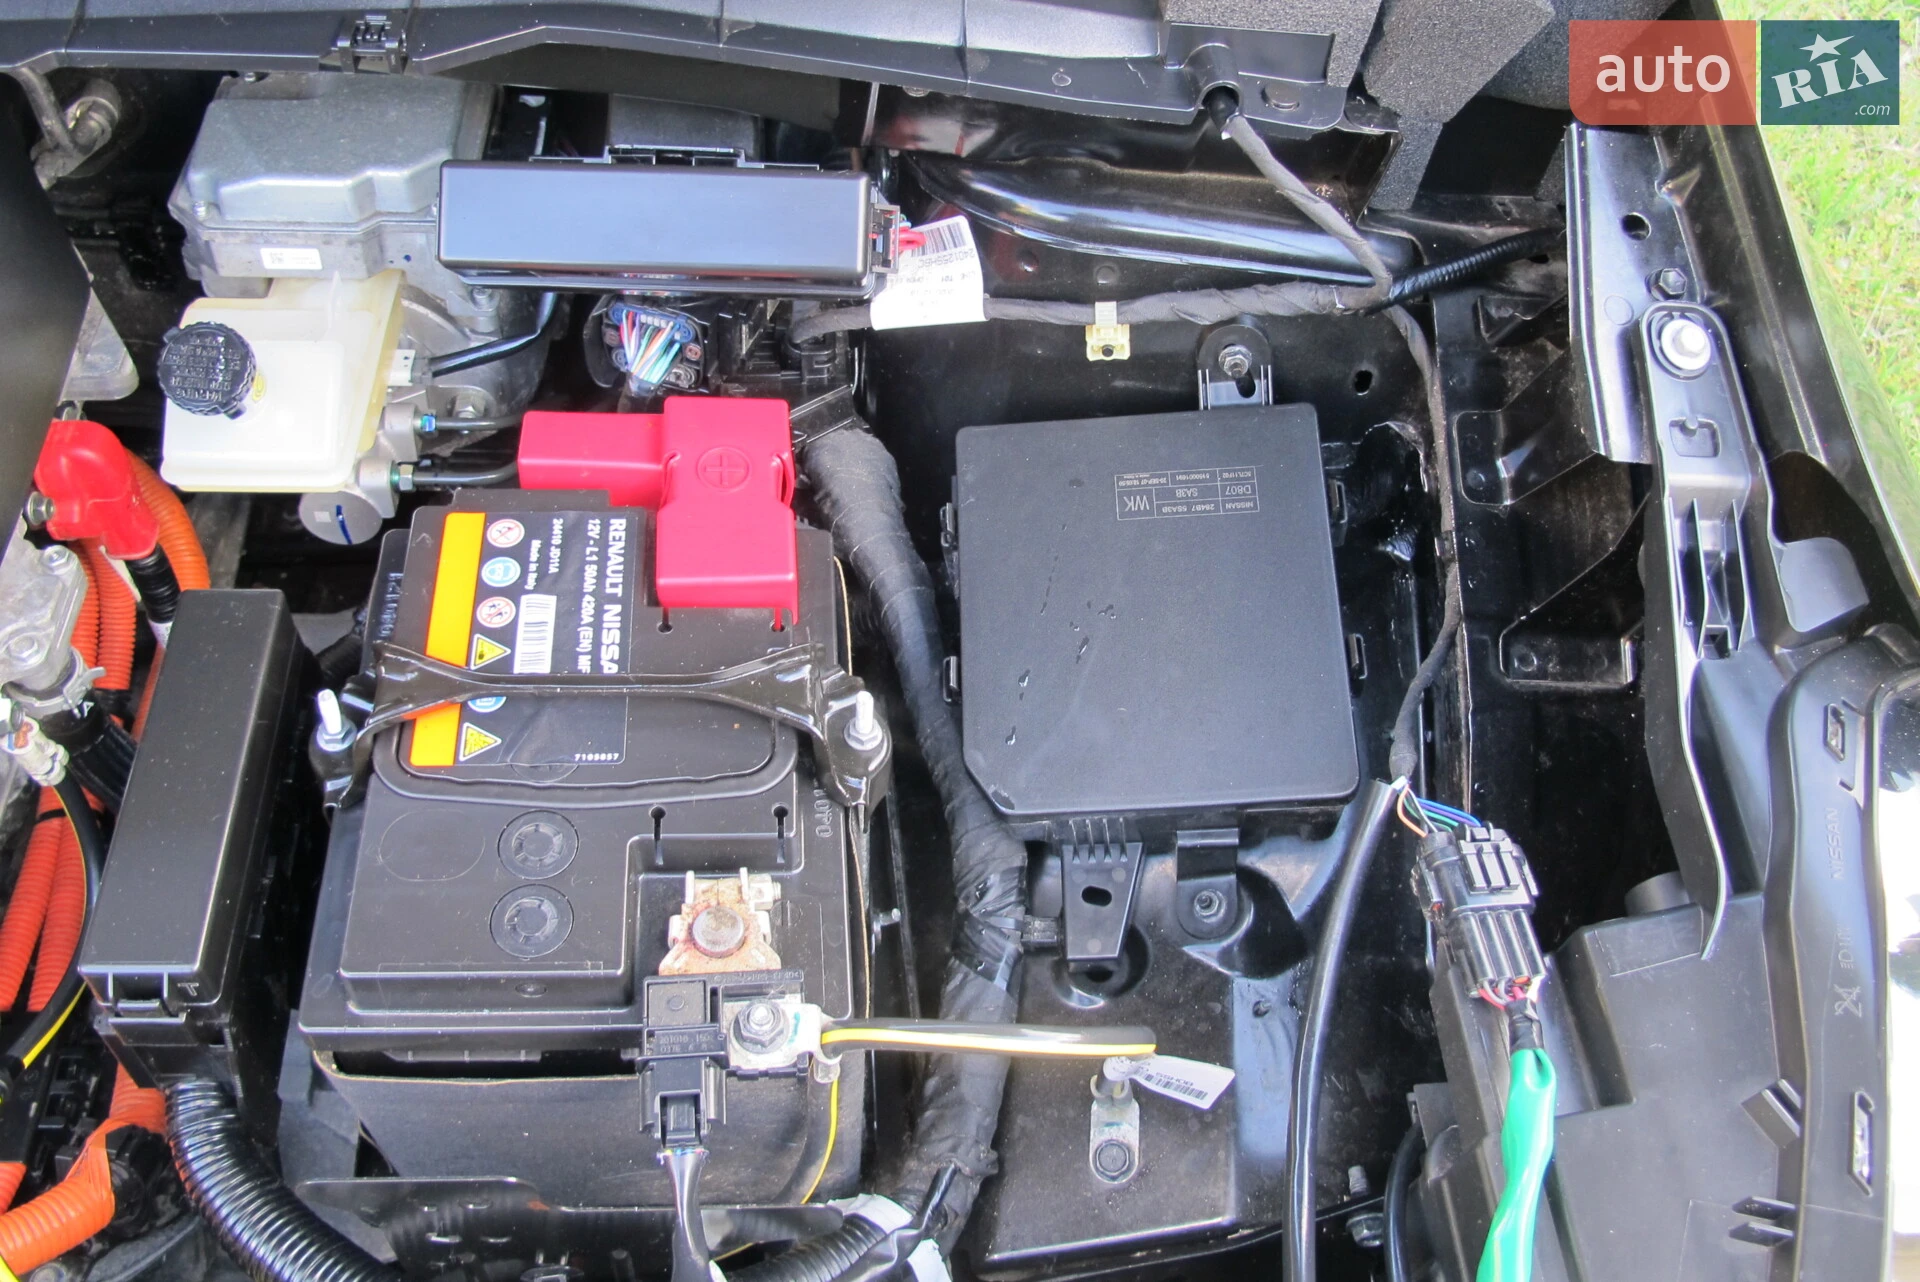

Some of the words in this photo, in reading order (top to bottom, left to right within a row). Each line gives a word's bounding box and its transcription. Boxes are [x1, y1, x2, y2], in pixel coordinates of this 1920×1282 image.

[1176, 488, 1198, 498] SA3B
[1225, 485, 1252, 495] D807
[1123, 495, 1150, 511] WK
[1225, 501, 1253, 510] NISSAN
[551, 518, 563, 545] 24410
[587, 518, 601, 539] 12V
[529, 539, 542, 562] Made
[605, 518, 626, 597] RENAULT
[529, 563, 539, 572] in
[583, 564, 598, 592] 50Ah
[524, 573, 538, 590] Italy
[581, 594, 595, 625] 420A
[576, 626, 593, 652] (EN)
[600, 604, 622, 674] NISSA
[1824, 807, 1844, 879] NISSAN
